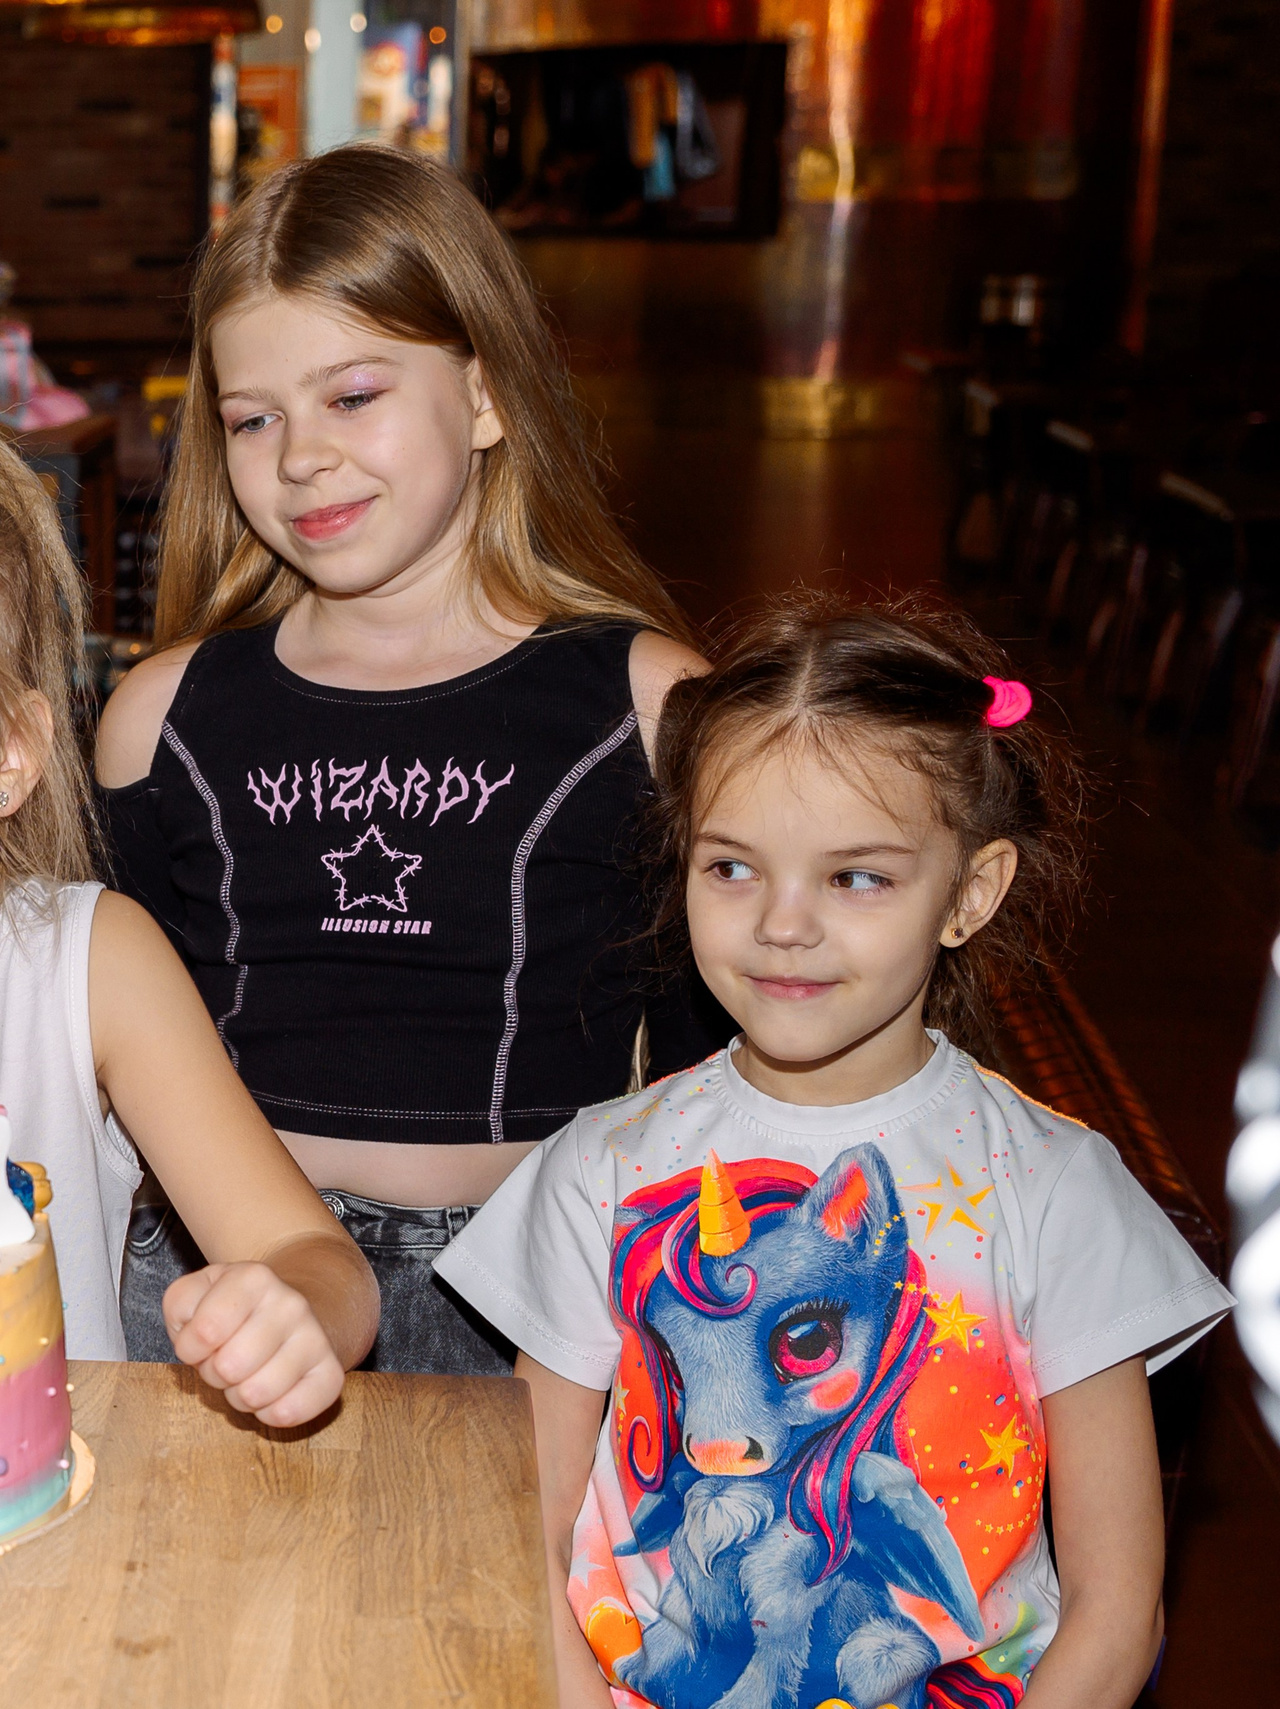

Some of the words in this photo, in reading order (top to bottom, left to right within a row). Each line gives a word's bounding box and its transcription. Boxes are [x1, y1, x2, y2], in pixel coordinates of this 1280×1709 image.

[247, 756, 515, 826] WIZARDY
[321, 917, 390, 934] ILLUSION
[393, 920, 432, 935] STAR
